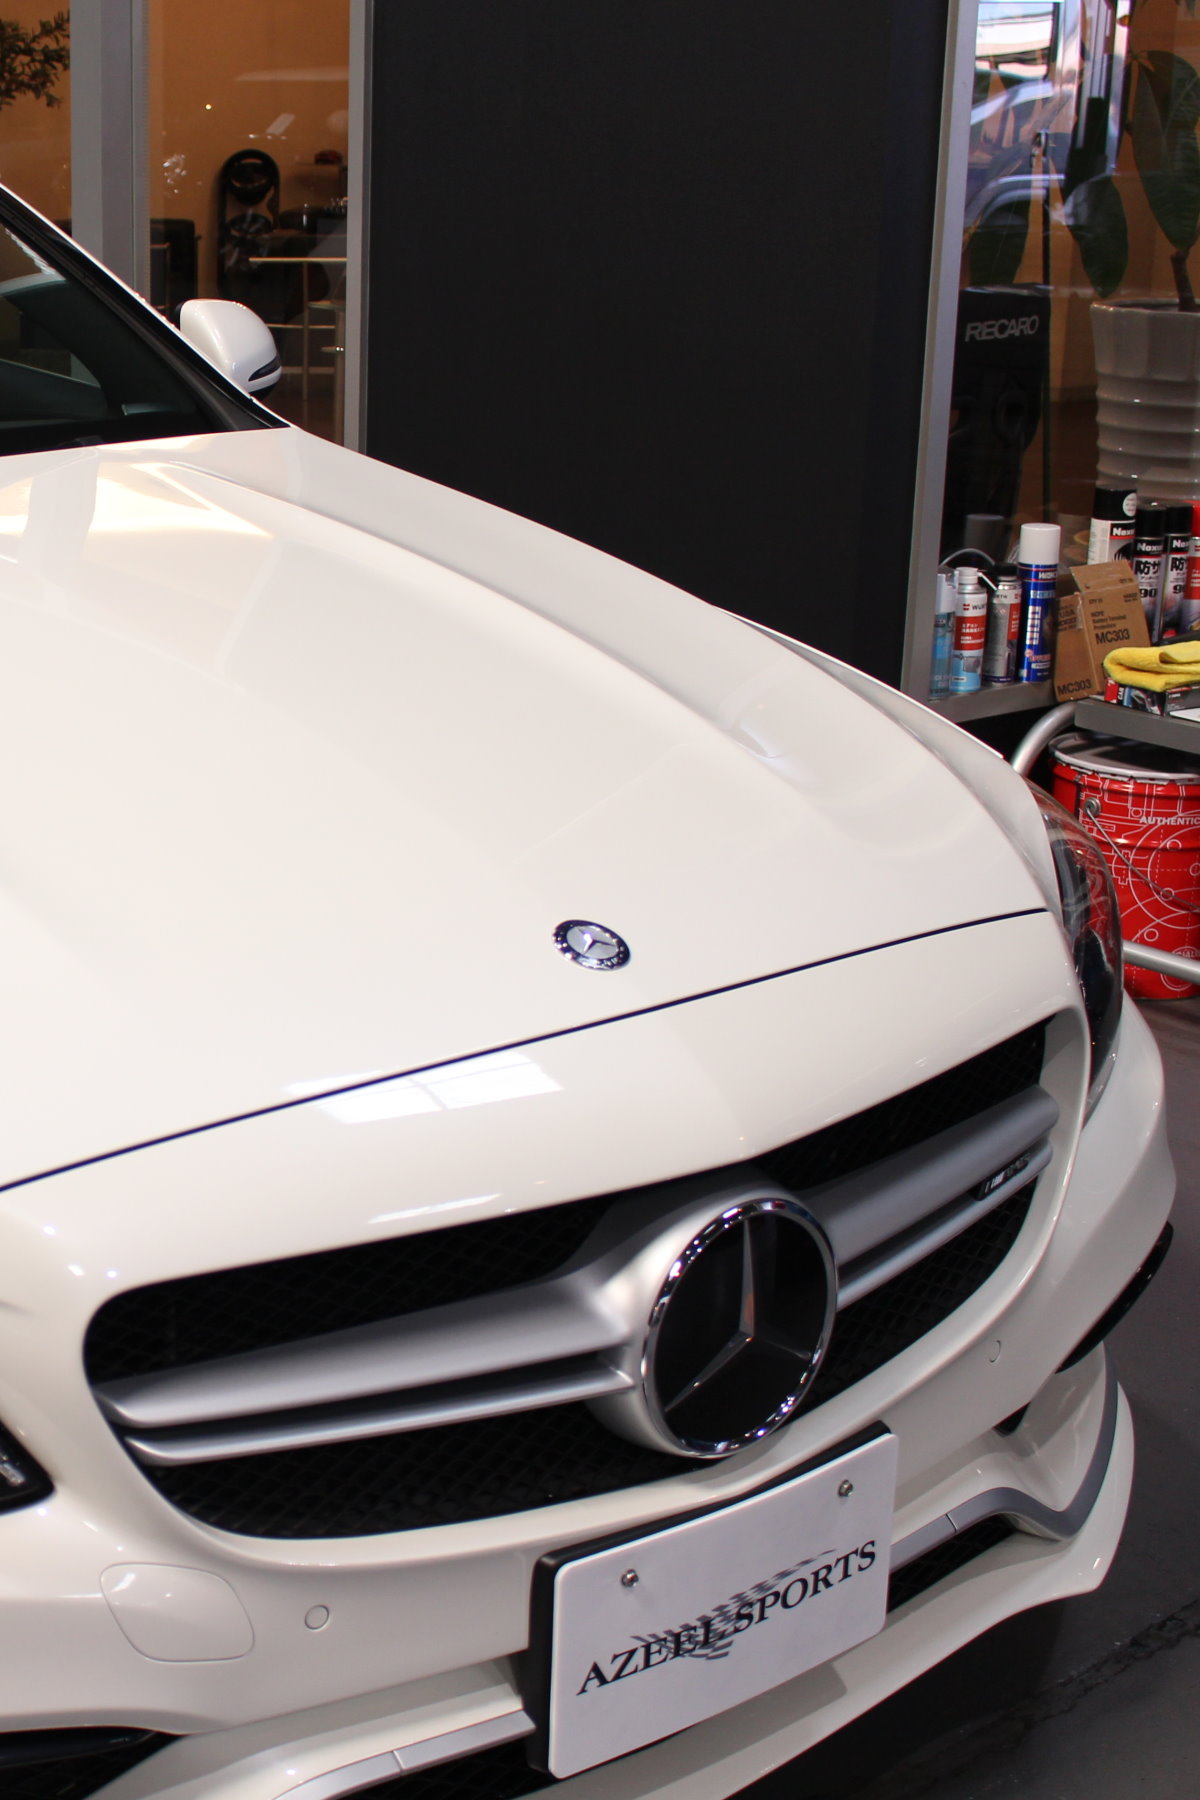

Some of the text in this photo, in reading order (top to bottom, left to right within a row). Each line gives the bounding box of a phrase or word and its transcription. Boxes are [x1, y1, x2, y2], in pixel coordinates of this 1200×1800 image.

[965, 315, 1039, 342] RECARO
[1095, 629, 1130, 645] MC303
[1057, 679, 1092, 695] MC303
[733, 1540, 877, 1633] SPORTS
